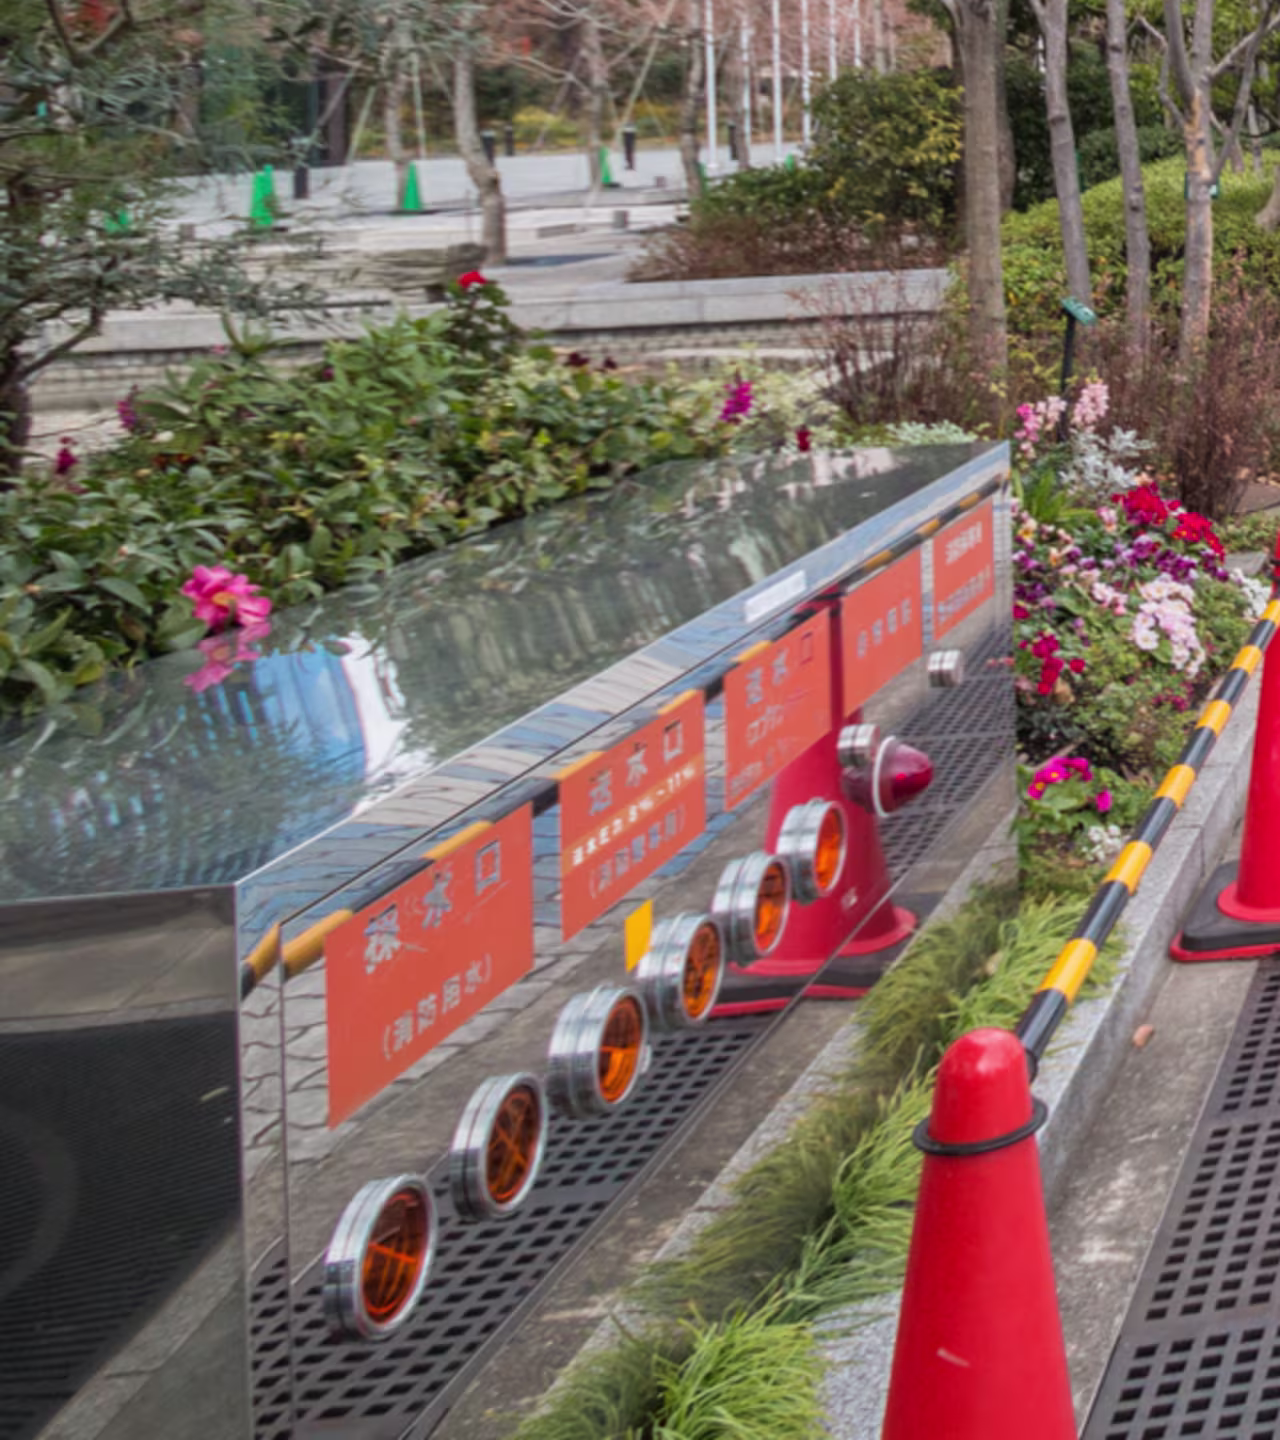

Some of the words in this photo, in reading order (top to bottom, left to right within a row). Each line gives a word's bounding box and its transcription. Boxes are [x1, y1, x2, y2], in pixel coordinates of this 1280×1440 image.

[588, 719, 684, 817] 送水口
[364, 840, 501, 975] 採水口
